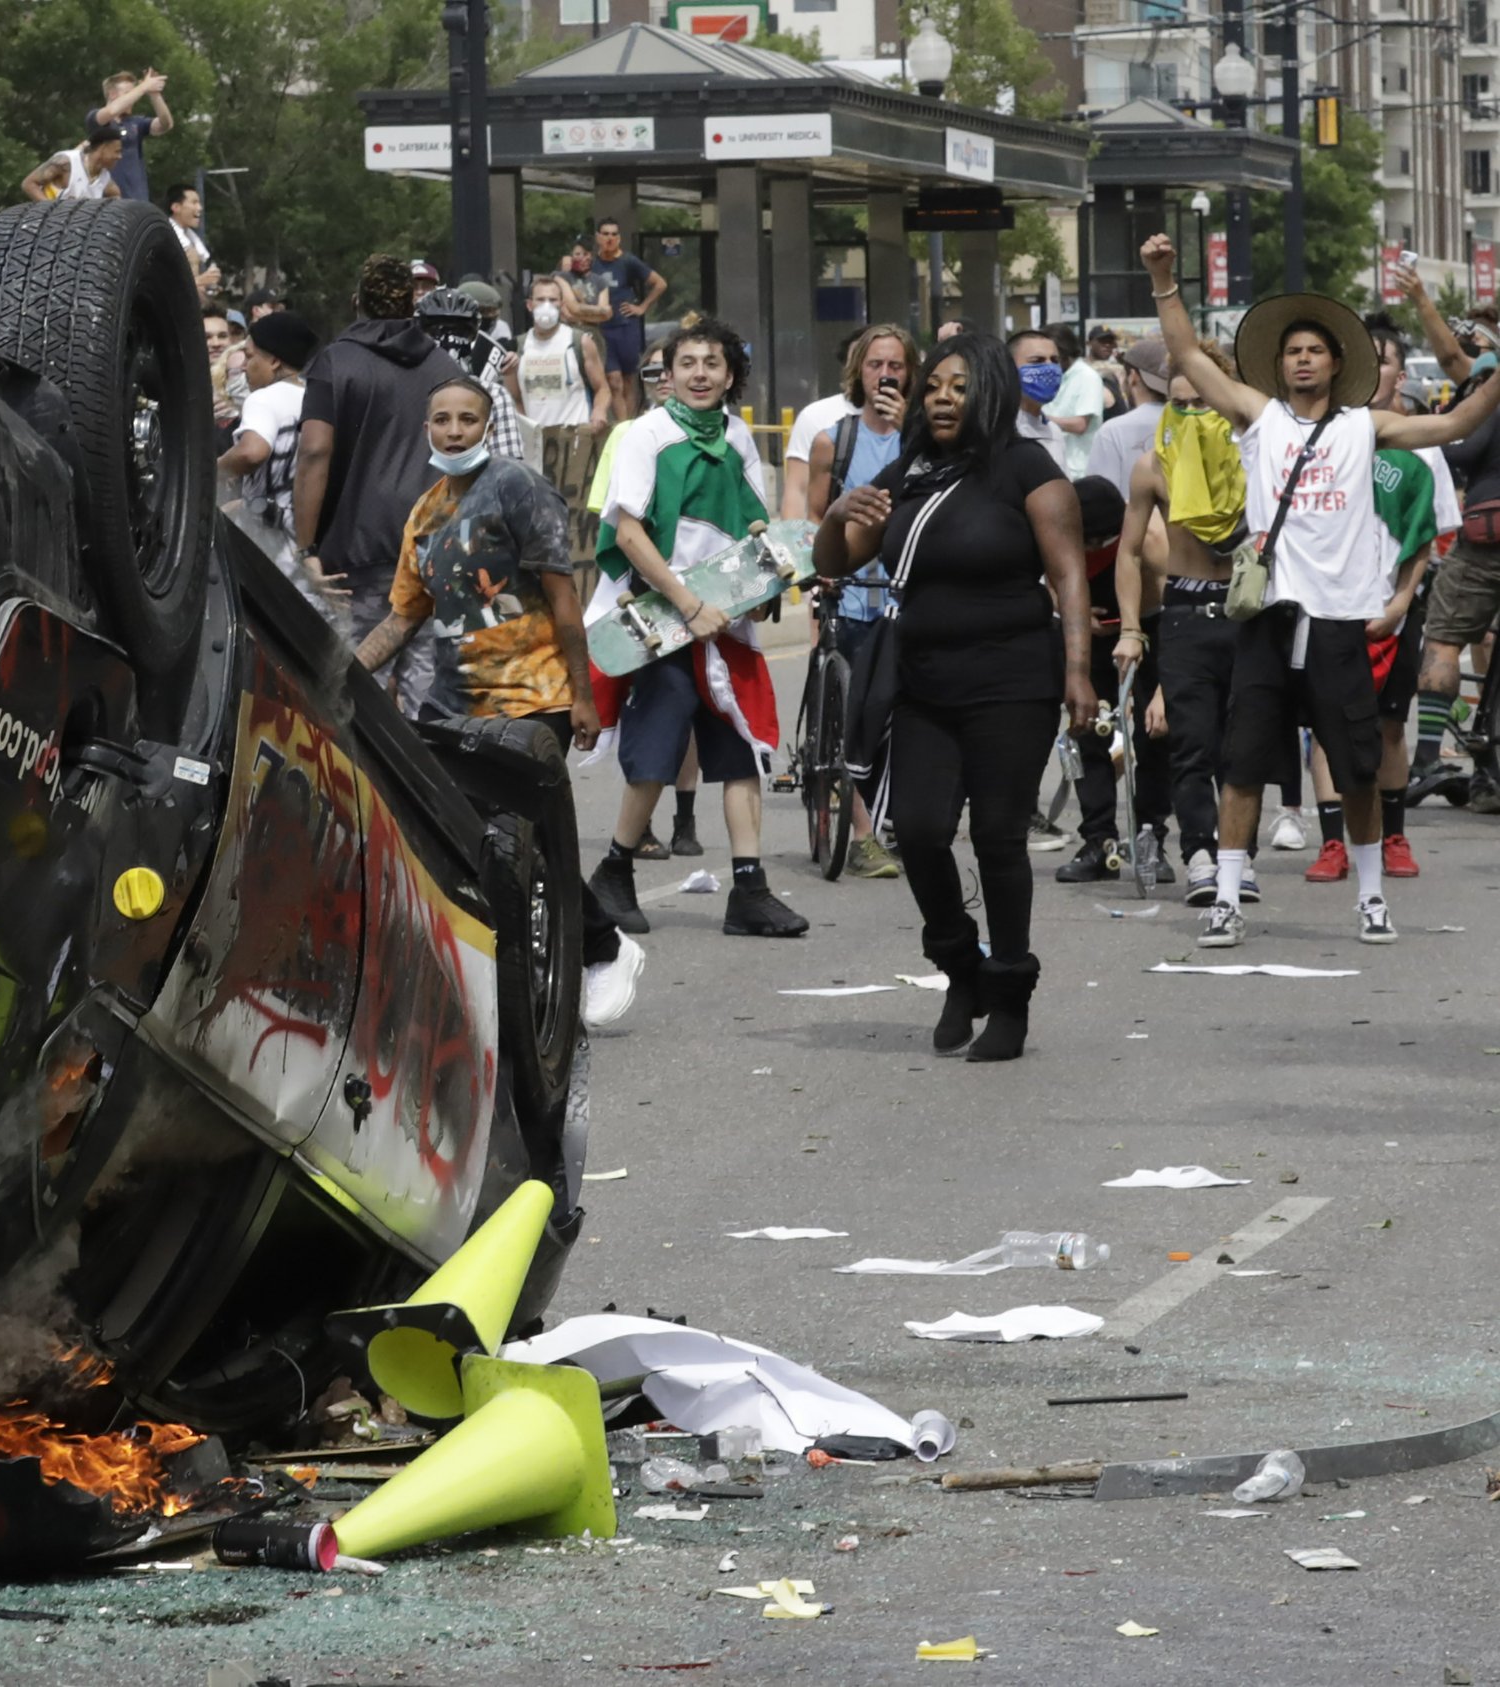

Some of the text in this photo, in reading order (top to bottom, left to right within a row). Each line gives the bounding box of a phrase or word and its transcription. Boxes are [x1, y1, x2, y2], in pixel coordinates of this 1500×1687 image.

[738, 132, 784, 142] UNIVERSITY
[786, 130, 822, 141] MEDICAL
[399, 142, 441, 153] DAYBREAK
